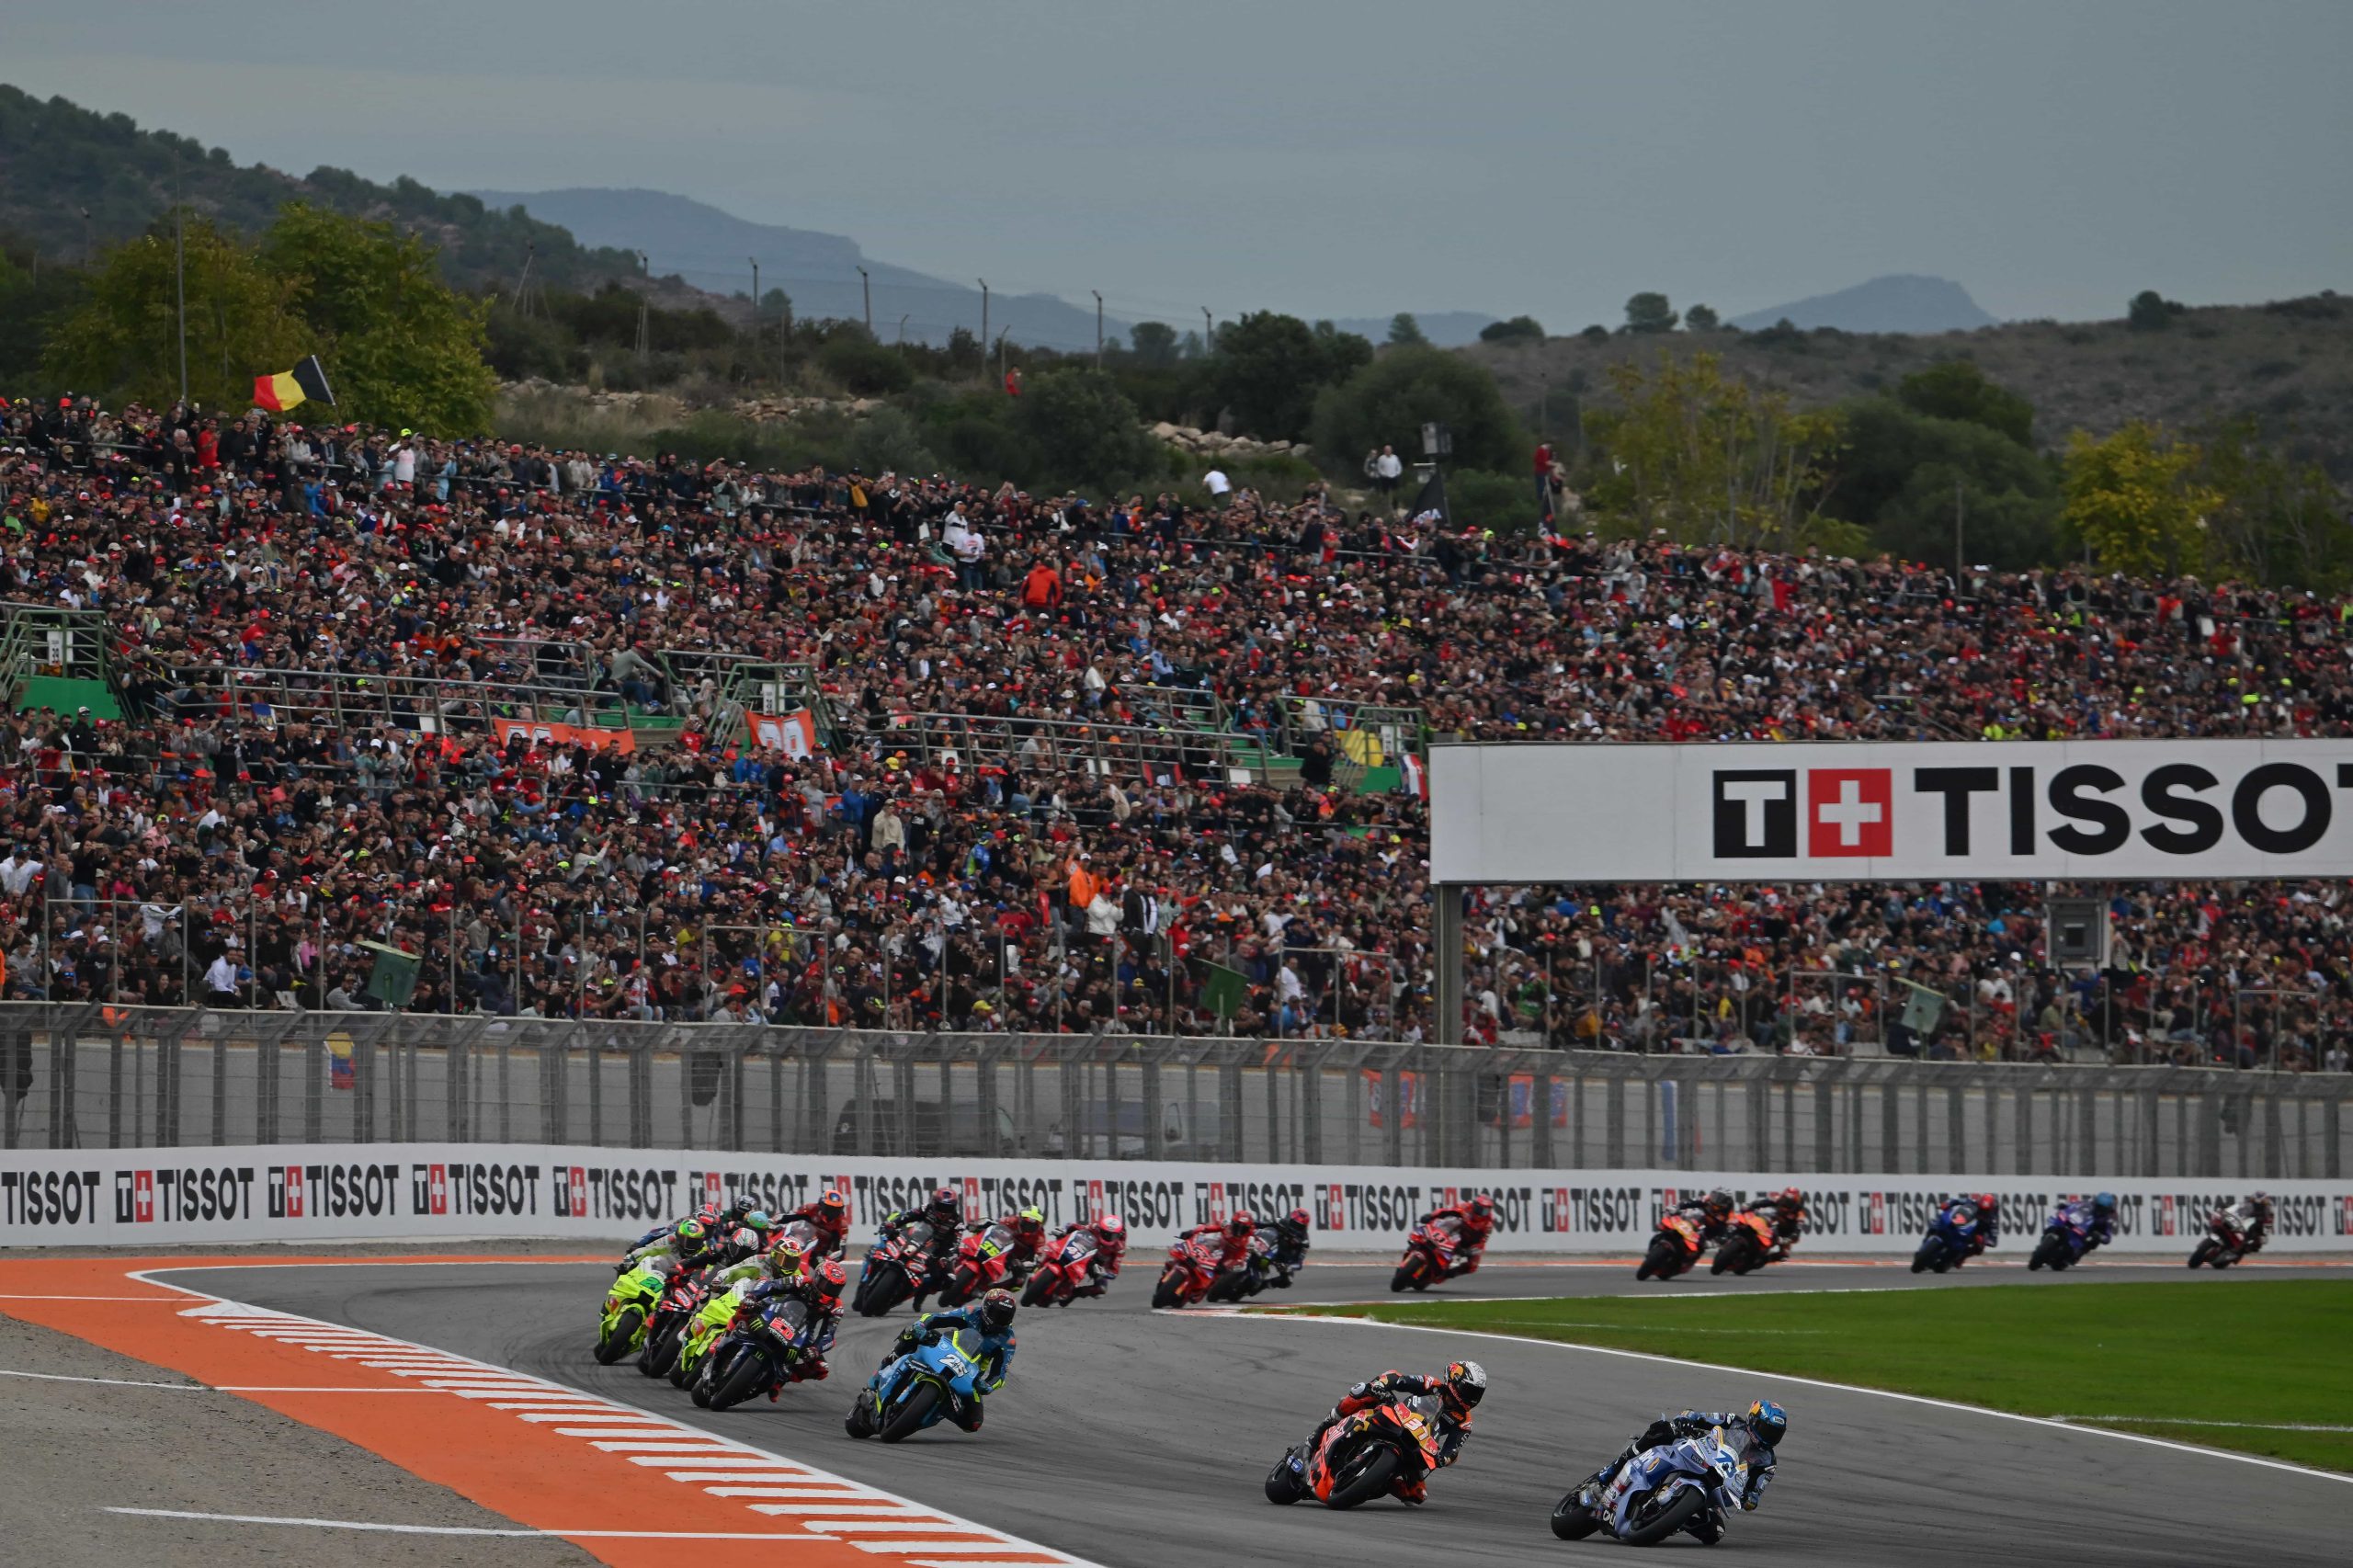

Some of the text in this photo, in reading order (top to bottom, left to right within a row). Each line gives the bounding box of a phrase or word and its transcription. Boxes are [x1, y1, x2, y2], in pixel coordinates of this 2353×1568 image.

[1915, 762, 2353, 856] TISSO
[1, 1170, 100, 1225] TISSOT
[156, 1166, 255, 1221] TISSOT
[306, 1164, 399, 1217] TISSOT
[449, 1164, 540, 1215] TISSOT
[588, 1168, 676, 1220] TISSOT
[724, 1172, 808, 1218] TISSOT
[981, 1177, 1062, 1227] TISSOT
[1105, 1180, 1184, 1229] TISSOT
[1226, 1183, 1303, 1224] TISSOT
[1345, 1185, 1419, 1232] TISSOT
[1571, 1187, 1641, 1233] TISSOT
[1885, 1192, 1949, 1234] TISSO
[2175, 1195, 2234, 1235] TISS
[2268, 1196, 2325, 1235] ISSOT
[1404, 1417, 1429, 1441] 37
